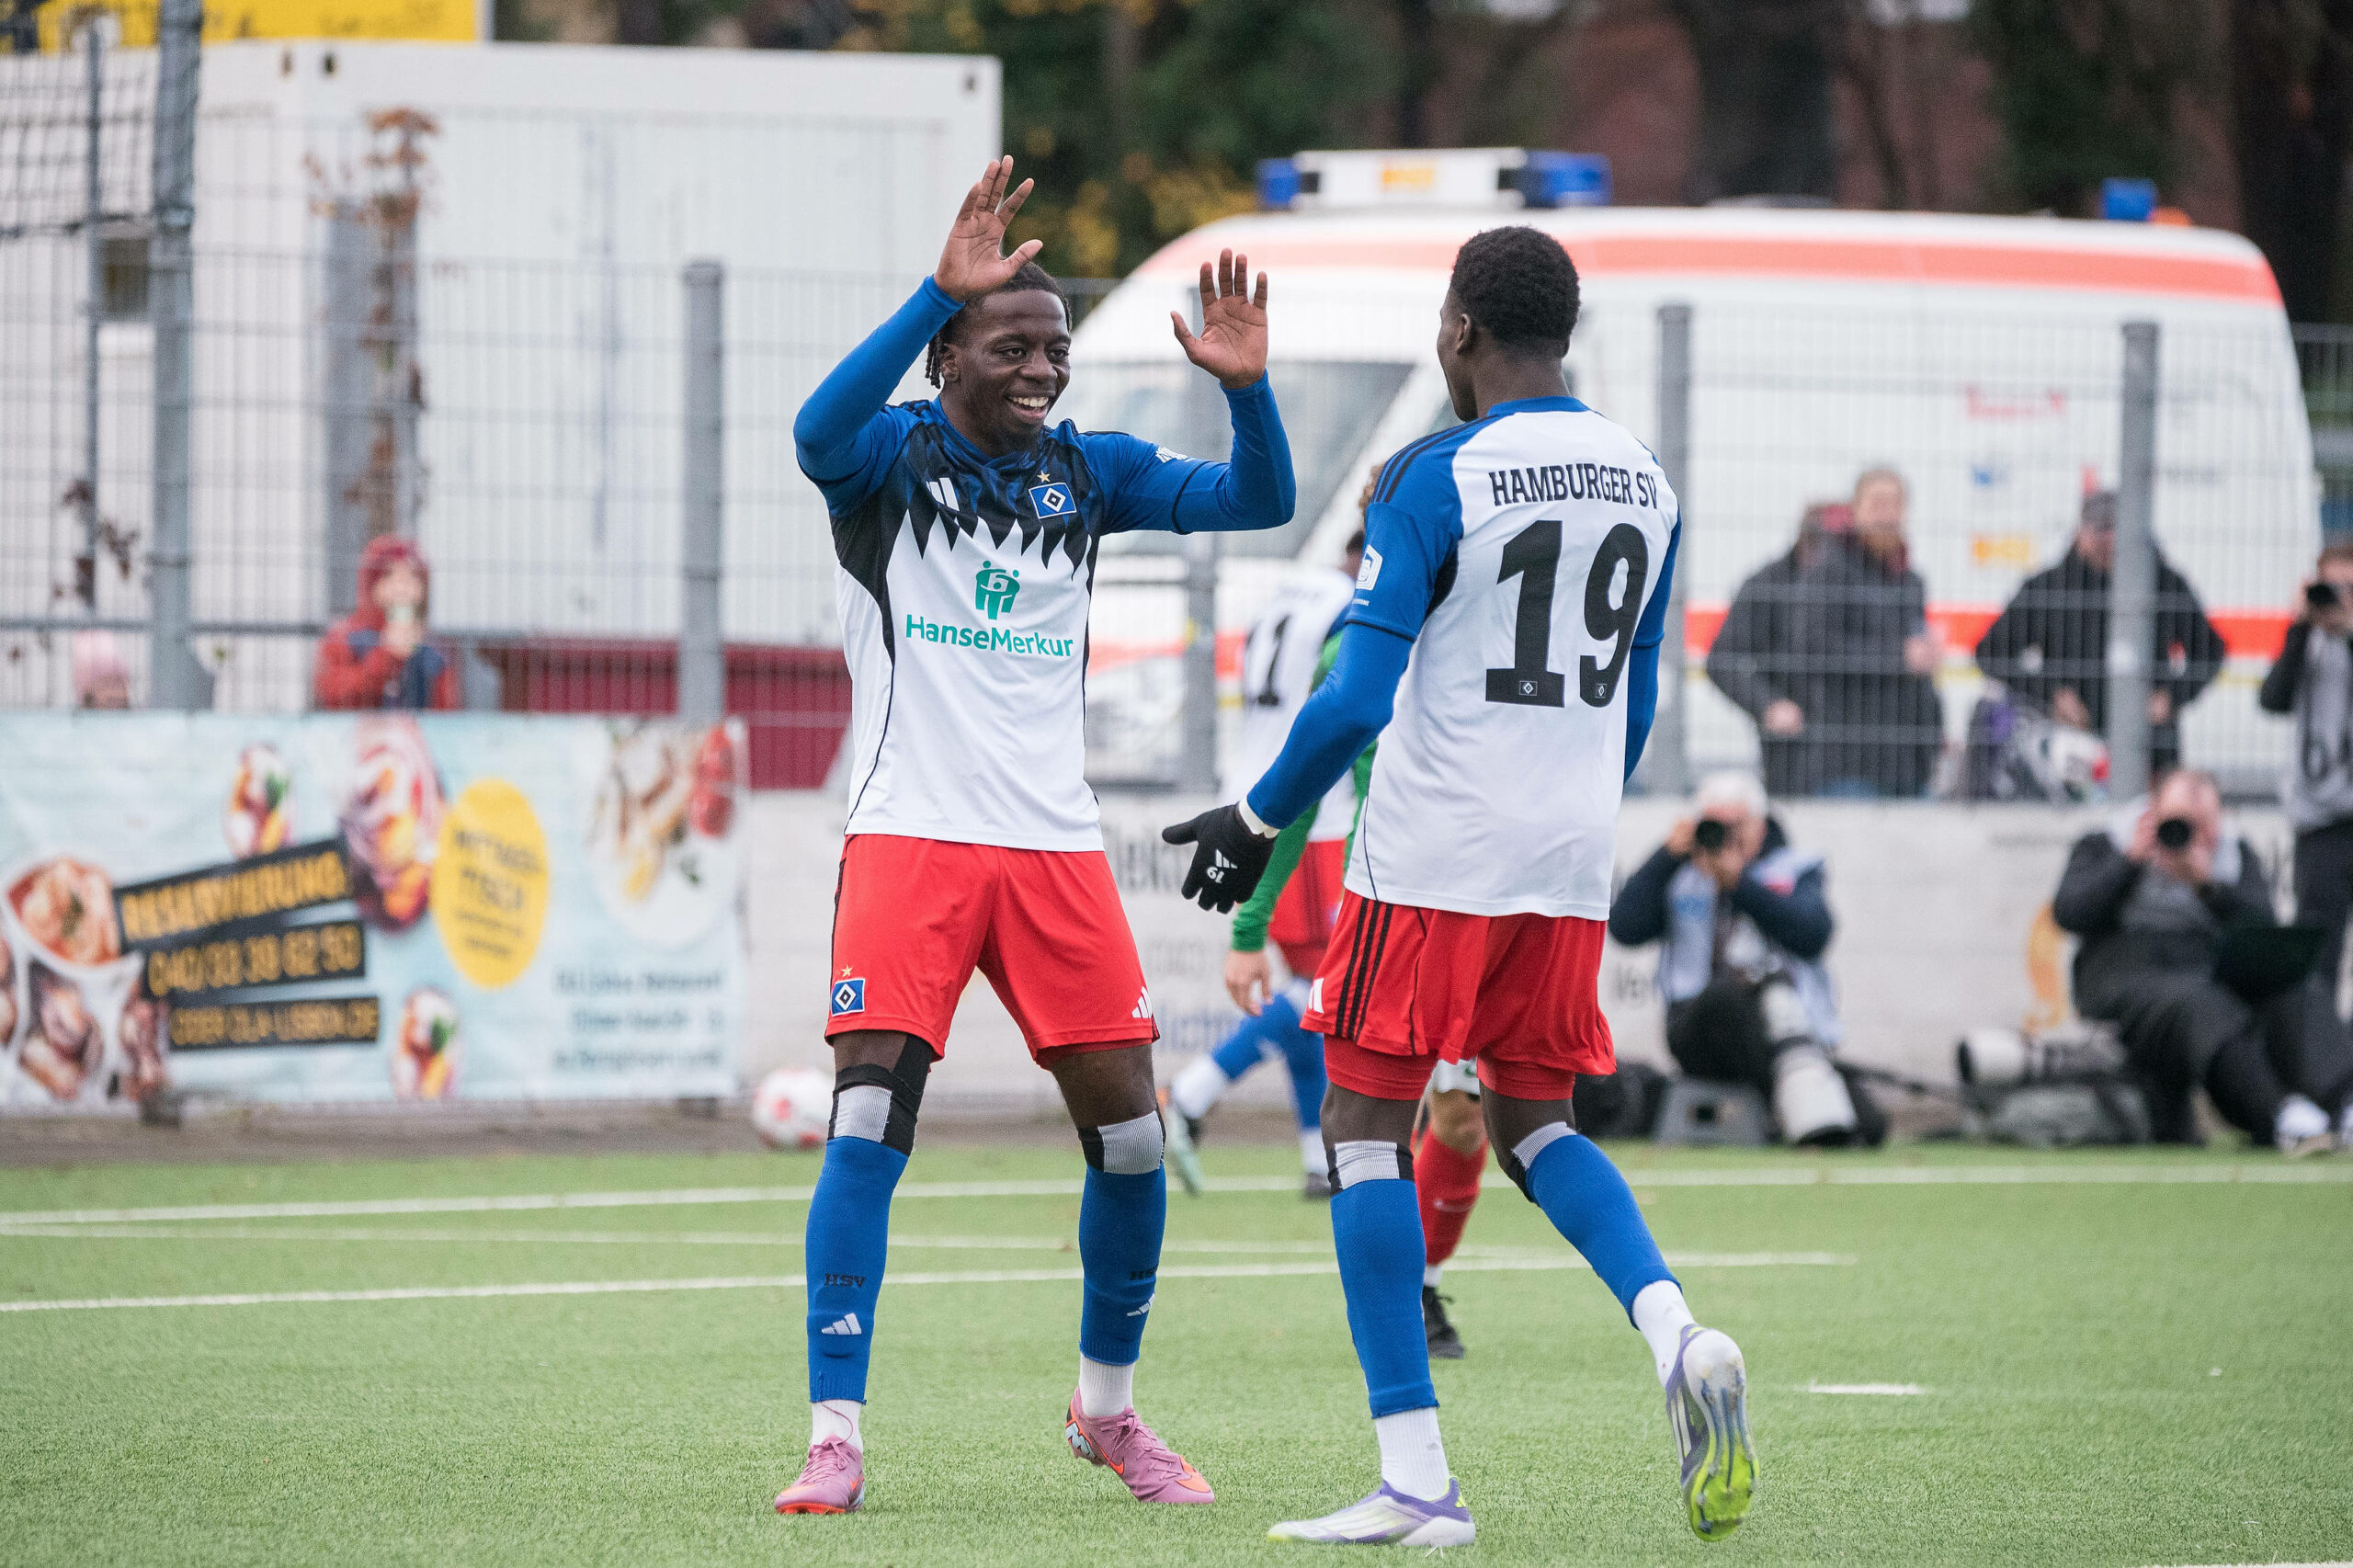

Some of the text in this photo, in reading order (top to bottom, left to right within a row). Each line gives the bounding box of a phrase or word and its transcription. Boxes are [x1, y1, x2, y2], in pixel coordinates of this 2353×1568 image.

[1488, 462, 1658, 509] HAMBURGER SV
[905, 614, 1074, 657] HanseMerkur
[1485, 520, 1649, 708] 19
[824, 1273, 867, 1288] HSV
